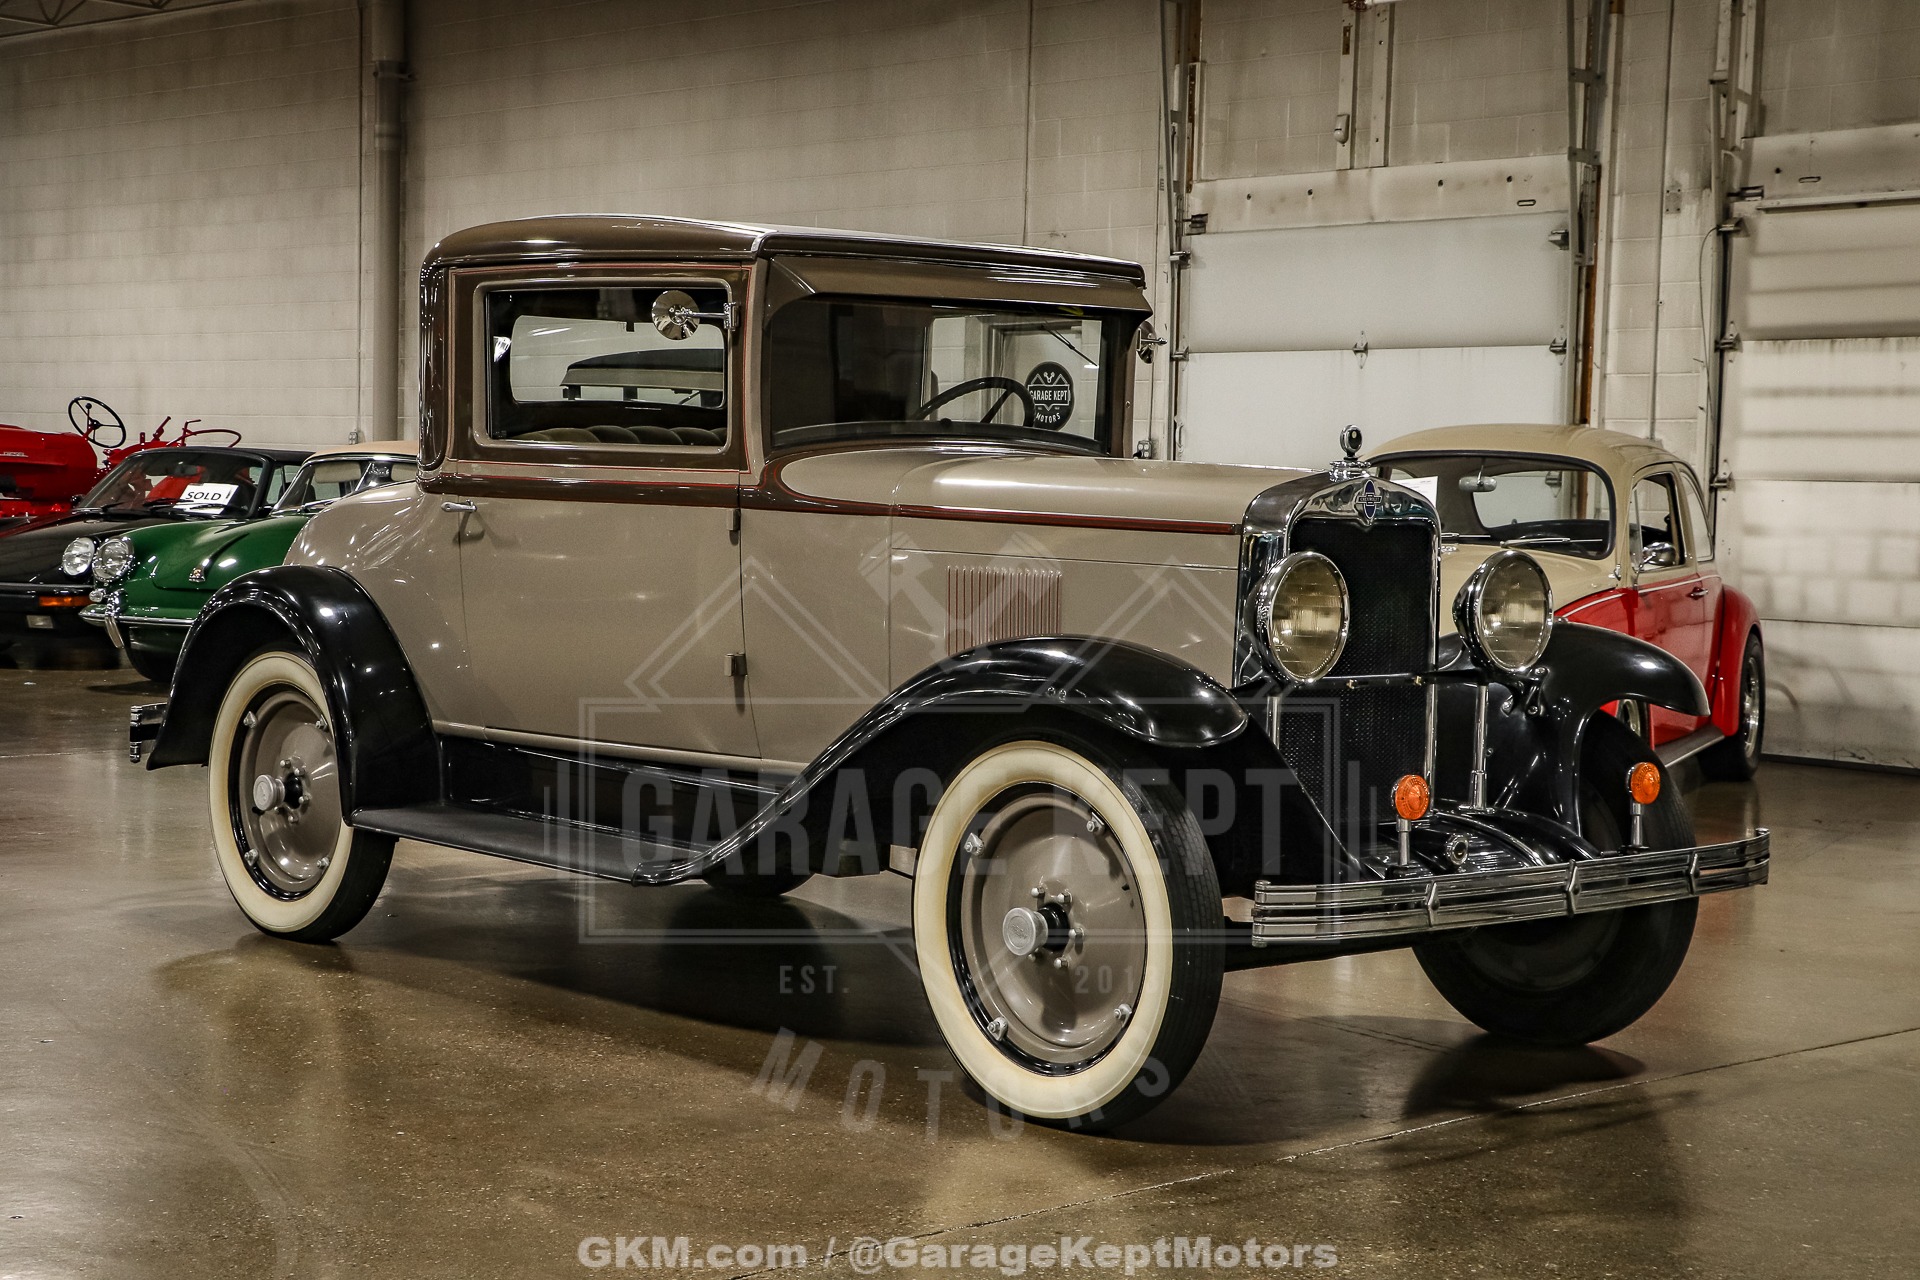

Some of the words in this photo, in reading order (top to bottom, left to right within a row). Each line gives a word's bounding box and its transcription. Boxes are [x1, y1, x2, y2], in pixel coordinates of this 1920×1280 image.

[1030, 390, 1052, 401] GARAGE
[1053, 390, 1068, 401] KEPT
[1036, 412, 1061, 423] MOTORS
[185, 491, 222, 501] SOLD
